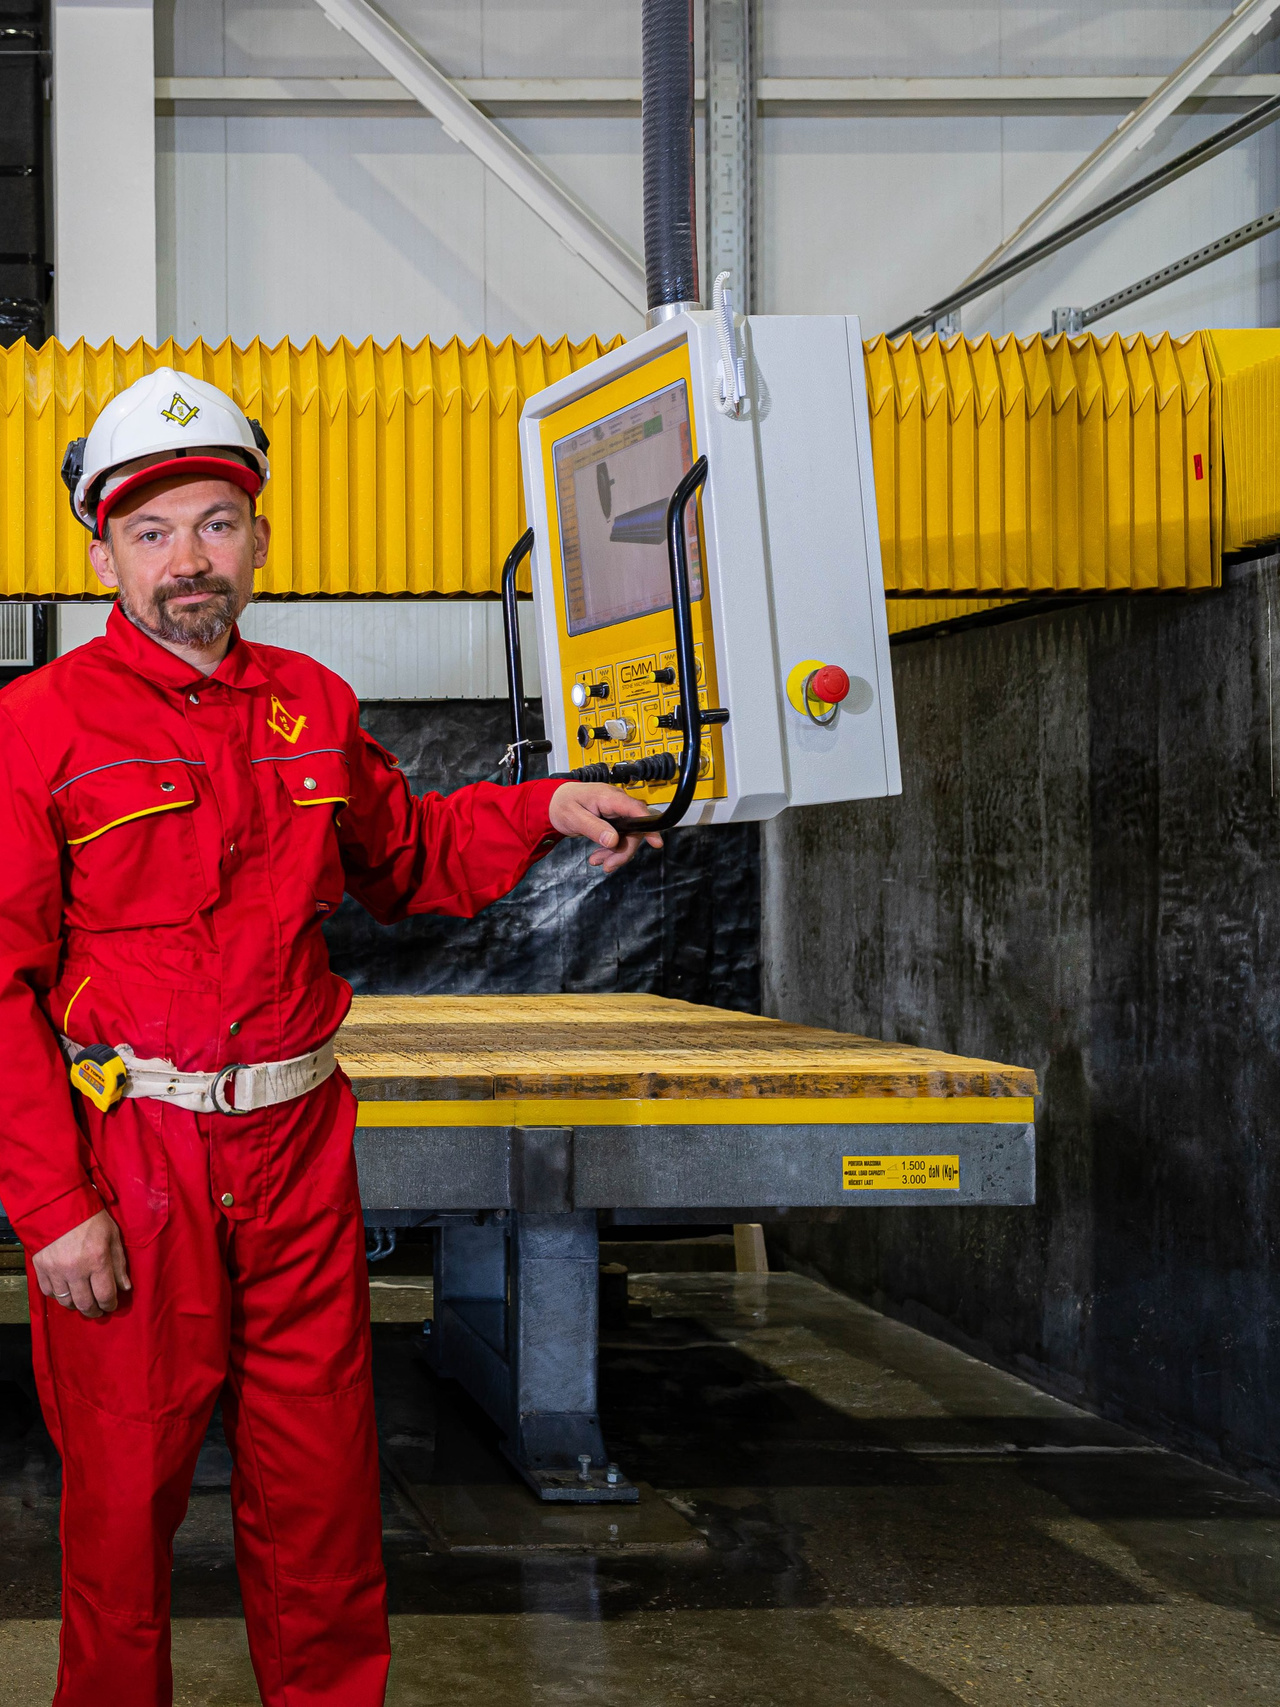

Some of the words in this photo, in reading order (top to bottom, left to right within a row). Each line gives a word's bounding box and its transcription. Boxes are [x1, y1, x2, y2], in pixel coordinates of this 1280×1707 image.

[621, 661, 652, 683] GMM
[901, 1160, 926, 1171] 1.500
[928, 1164, 940, 1178] daN
[942, 1164, 955, 1181] (Kg)
[901, 1174, 927, 1185] 3.000
